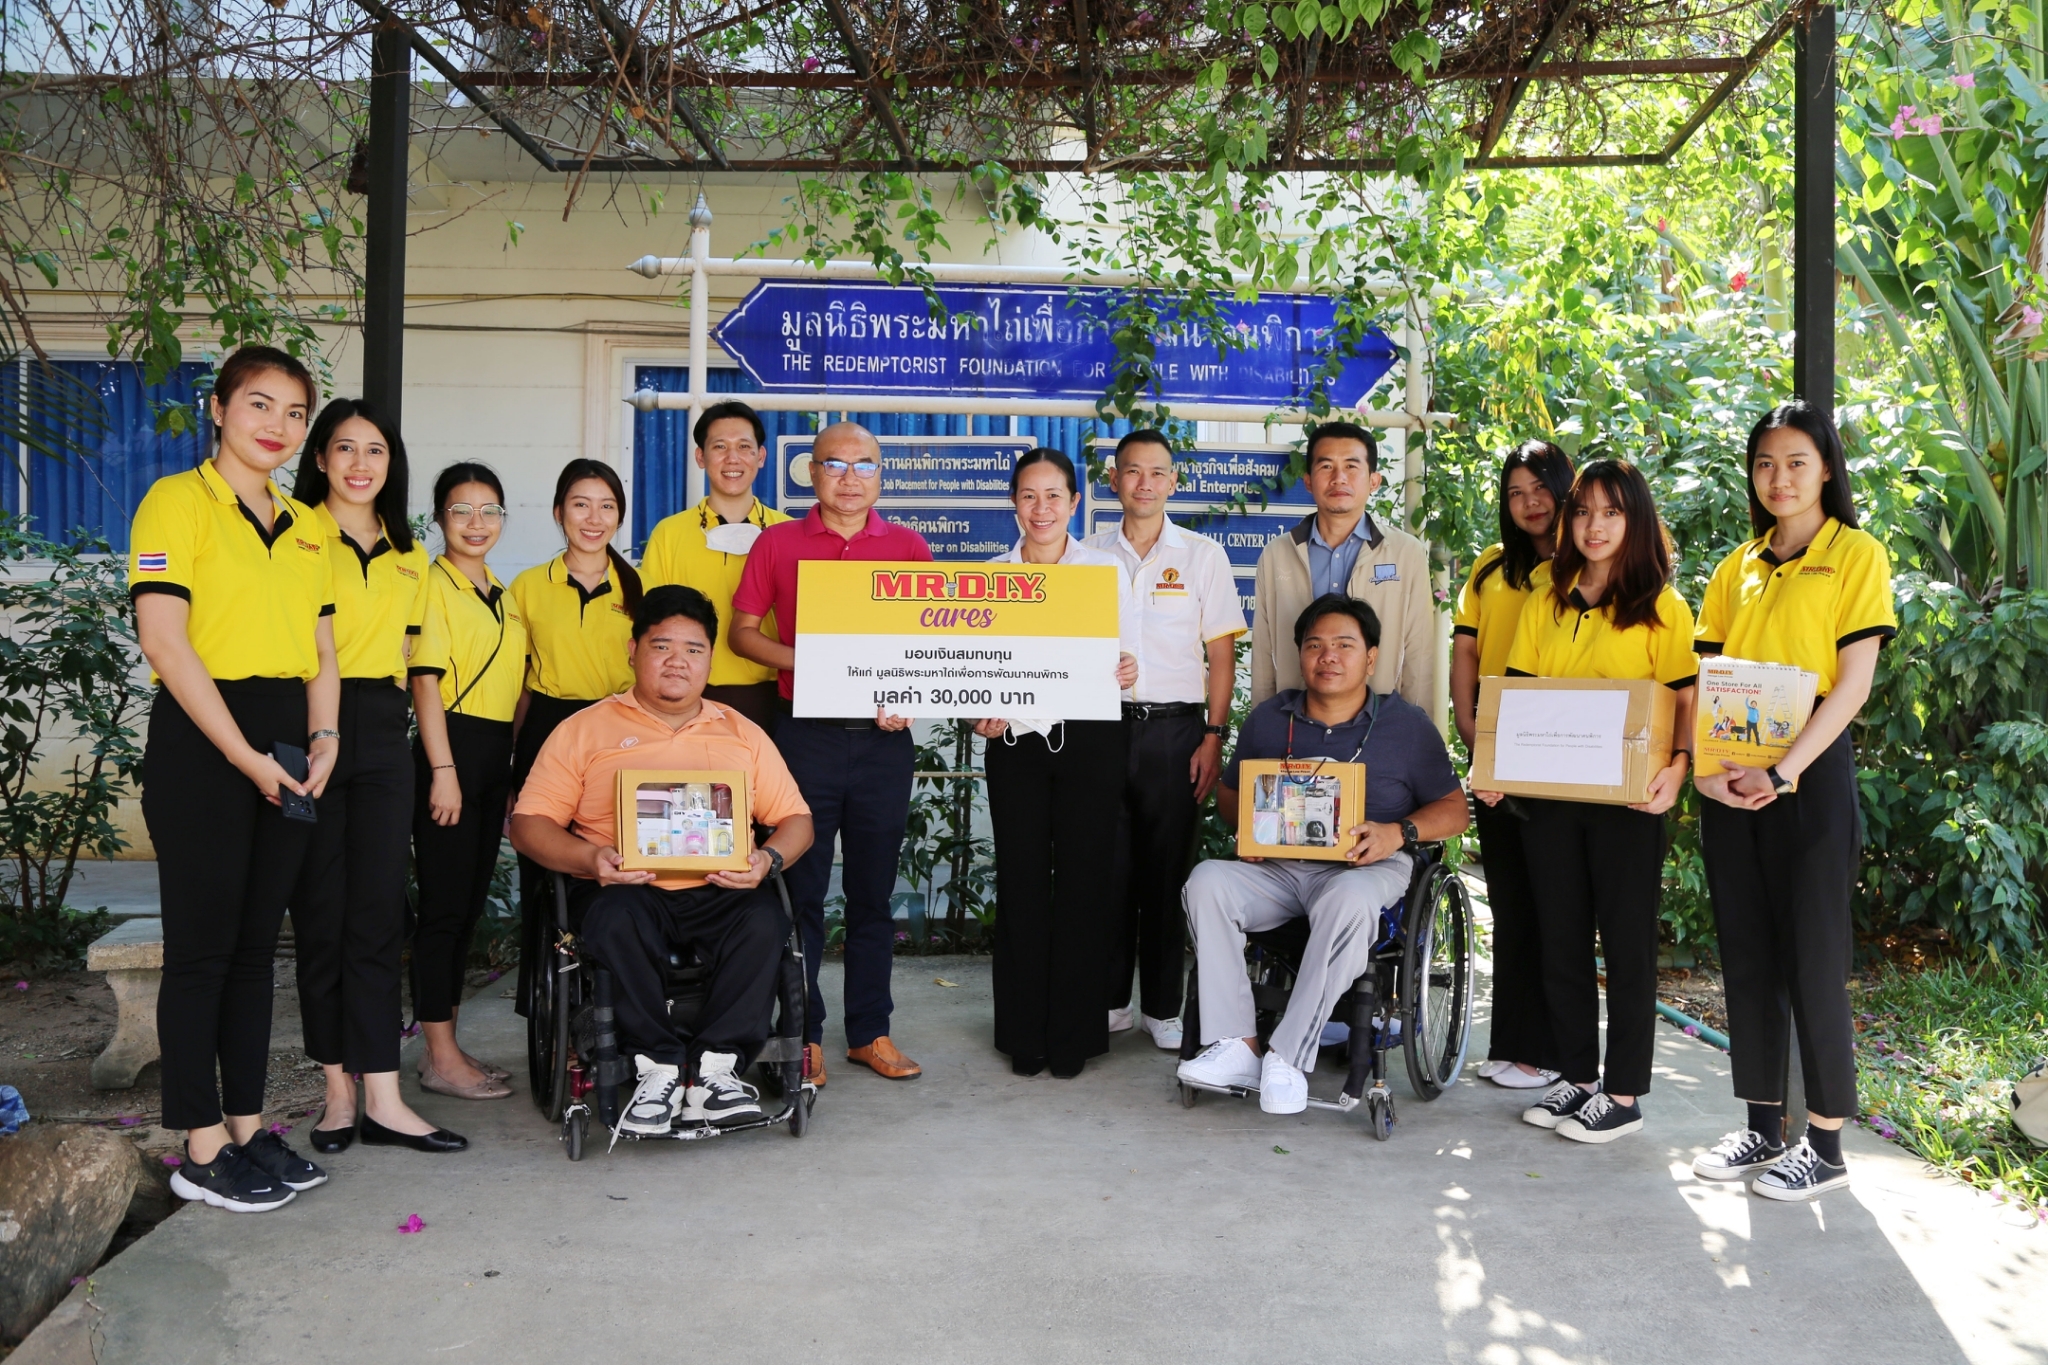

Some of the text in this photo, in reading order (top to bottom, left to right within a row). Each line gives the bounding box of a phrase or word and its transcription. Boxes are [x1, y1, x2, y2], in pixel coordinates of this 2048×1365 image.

[782, 354, 811, 371] THE
[824, 355, 946, 374] REDEMPTORIST
[959, 357, 1062, 378] FOUNDATION
[1190, 364, 1228, 382] WITH
[883, 479, 894, 490] Job
[895, 479, 927, 490] Placement
[928, 479, 938, 490] for
[939, 479, 959, 492] People
[961, 479, 975, 490] with
[976, 479, 1009, 490] Disabilities
[946, 543, 958, 553] on
[960, 541, 1010, 553] Disabilities
[1227, 533, 1264, 548] CENTER
[920, 607, 998, 628] cares
[905, 647, 1012, 663] มอบเงินสมทบทุน
[847, 666, 872, 677] ให้แก่
[873, 686, 1035, 707] มูลค่า 30,000 บาท
[1706, 686, 1761, 695] SATISFACTION!
